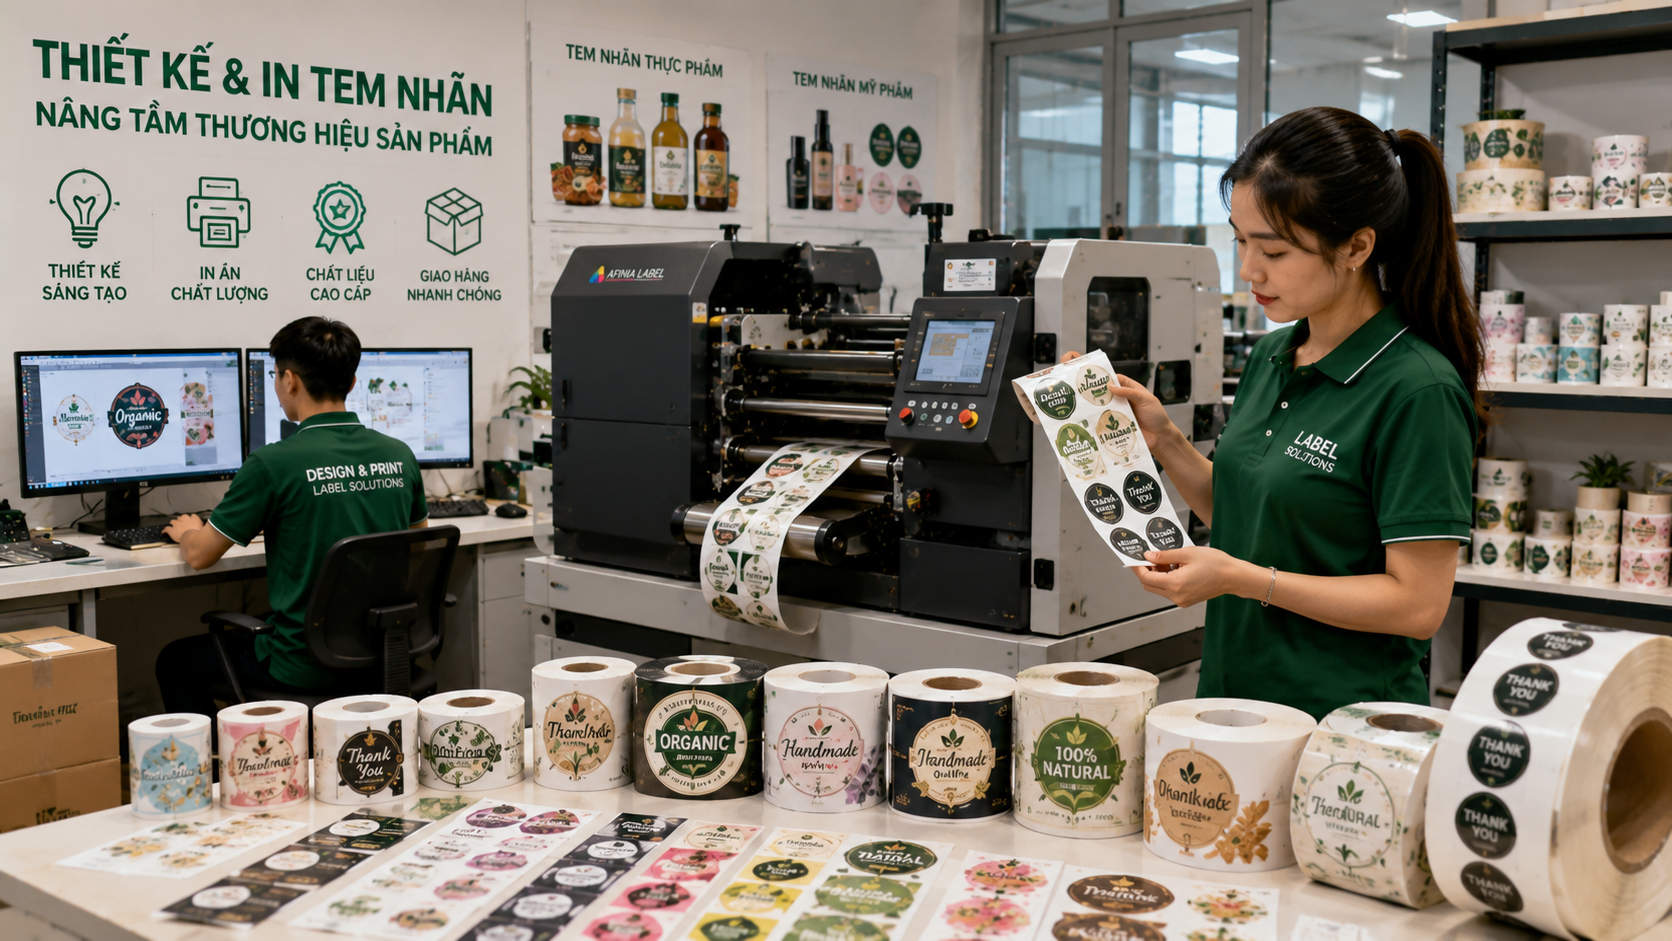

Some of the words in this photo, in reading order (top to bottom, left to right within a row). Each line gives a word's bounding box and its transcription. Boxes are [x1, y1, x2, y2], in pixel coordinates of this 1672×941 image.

[565, 43, 596, 62] TEM
[644, 54, 682, 76] THỰC
[32, 32, 150, 86] THIẾT
[162, 41, 214, 92] KẾ
[222, 57, 251, 96] &
[262, 61, 299, 100] IN
[310, 65, 385, 108] TEM
[397, 71, 492, 117] NHÃN
[792, 71, 818, 88] TEM
[36, 96, 121, 131] NÂNG
[129, 99, 188, 135] TẦM
[195, 113, 306, 144] THƯƠNG
[314, 118, 369, 152] HIỆU
[376, 122, 422, 151] SẢN
[429, 126, 492, 157] PHẨM
[200, 266, 215, 280] IN
[420, 269, 451, 282] GIAO
[606, 269, 636, 279] AFINIA
[636, 268, 665, 279] LABEL
[42, 282, 89, 300] SÁNG
[94, 285, 127, 304] TẠO
[216, 285, 269, 304] LƯỢNG
[310, 287, 340, 301] CAO
[407, 288, 453, 301] NHANH
[456, 285, 502, 301] CHÓNG
[115, 408, 162, 427] Organic
[1293, 430, 1338, 460] LABEL
[306, 465, 356, 482] DESIGN
[358, 464, 369, 477] &
[369, 461, 403, 476] PRINT
[313, 482, 347, 496] LABEL
[349, 477, 404, 492] SOLUTIONS
[1506, 673, 1554, 692] THANK
[1509, 686, 1538, 701] YOU
[660, 733, 731, 751] ORGANIC
[781, 738, 859, 760] Handmade
[1479, 736, 1525, 758] THANK
[346, 746, 391, 764] Thank
[1055, 746, 1097, 763] 100%
[1483, 751, 1511, 769] YOU
[356, 764, 384, 780] You
[1043, 760, 1111, 780] NATURAL
[1463, 808, 1509, 833] THANK
[1471, 825, 1499, 843] YOU
